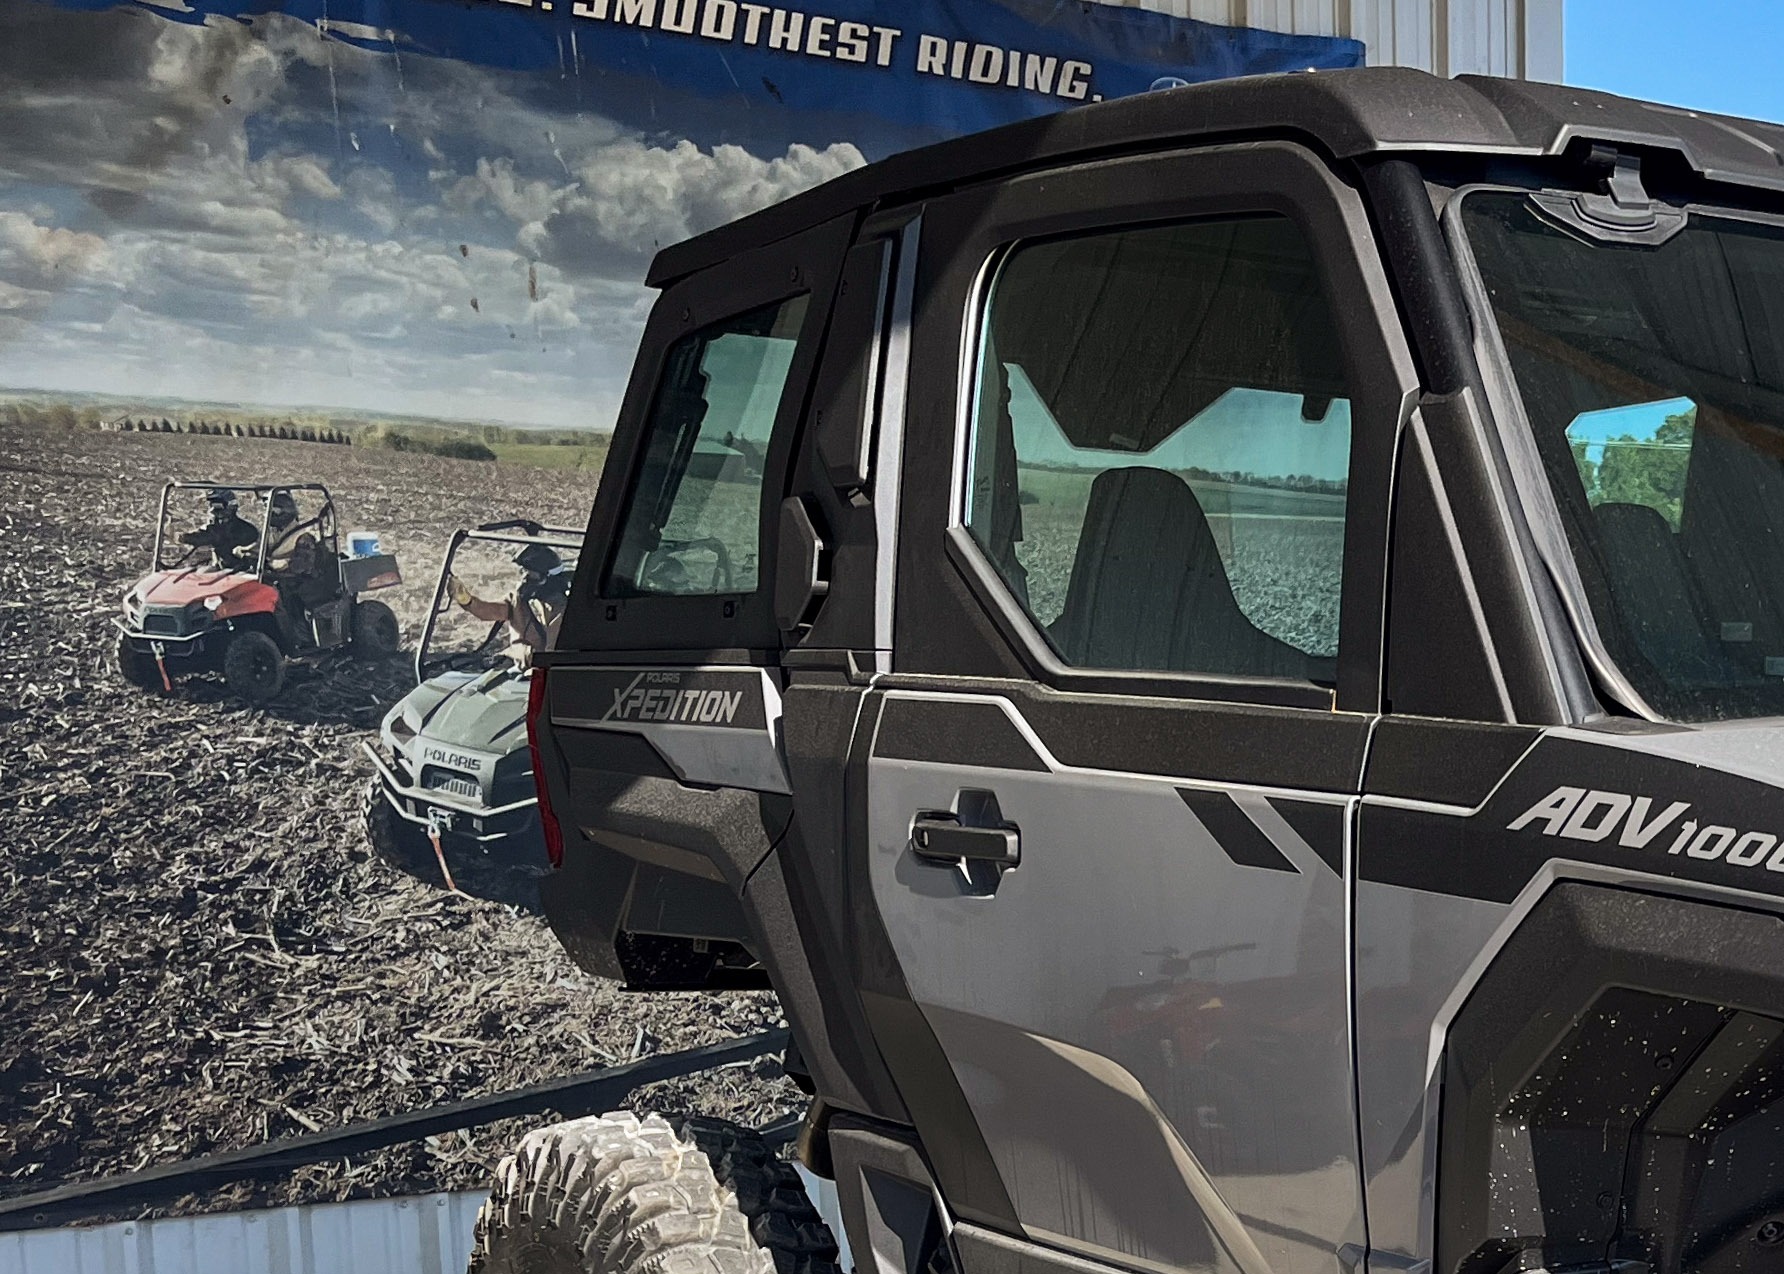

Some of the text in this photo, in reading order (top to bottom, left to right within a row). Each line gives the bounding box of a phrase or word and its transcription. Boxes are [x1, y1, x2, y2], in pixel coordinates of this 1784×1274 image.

[917, 34, 1102, 102] RIDING.
[600, 672, 743, 723] XPEDITION
[647, 672, 680, 683] POLARIS
[424, 747, 482, 771] POLARIS
[1506, 786, 1691, 849] ADV
